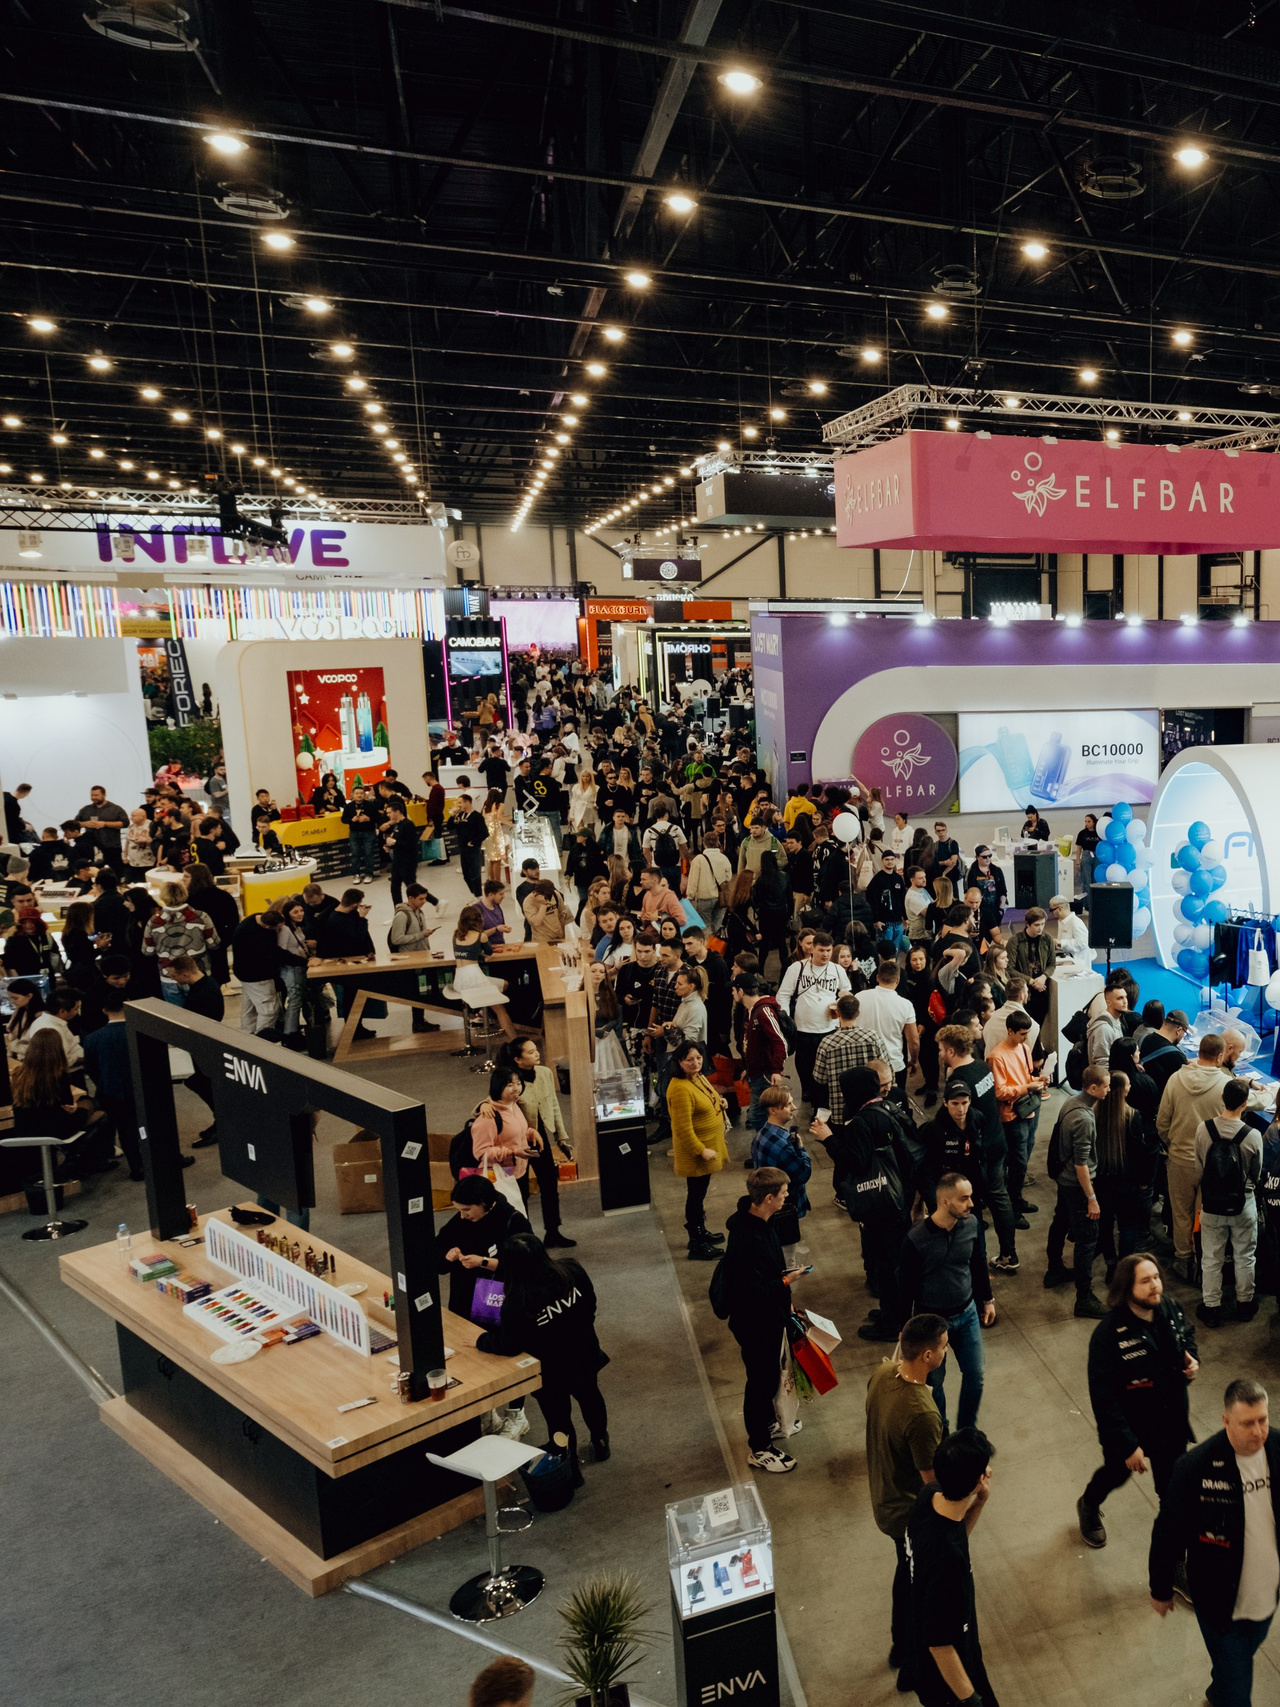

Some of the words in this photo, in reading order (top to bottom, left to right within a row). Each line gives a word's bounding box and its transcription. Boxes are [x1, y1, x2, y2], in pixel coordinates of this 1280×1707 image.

[856, 474, 900, 513] ELFBAR
[1075, 476, 1235, 514] ELFBAR
[448, 637, 501, 648] CAMOBAR
[317, 674, 357, 684] VOOPOO
[1081, 742, 1144, 757] BC10000
[1086, 758, 1113, 766] Illuminate
[878, 784, 936, 798] LFBAR
[223, 1052, 268, 1095] ENVA
[488, 1293, 505, 1301] LOS
[701, 1669, 767, 1705] ENVA
